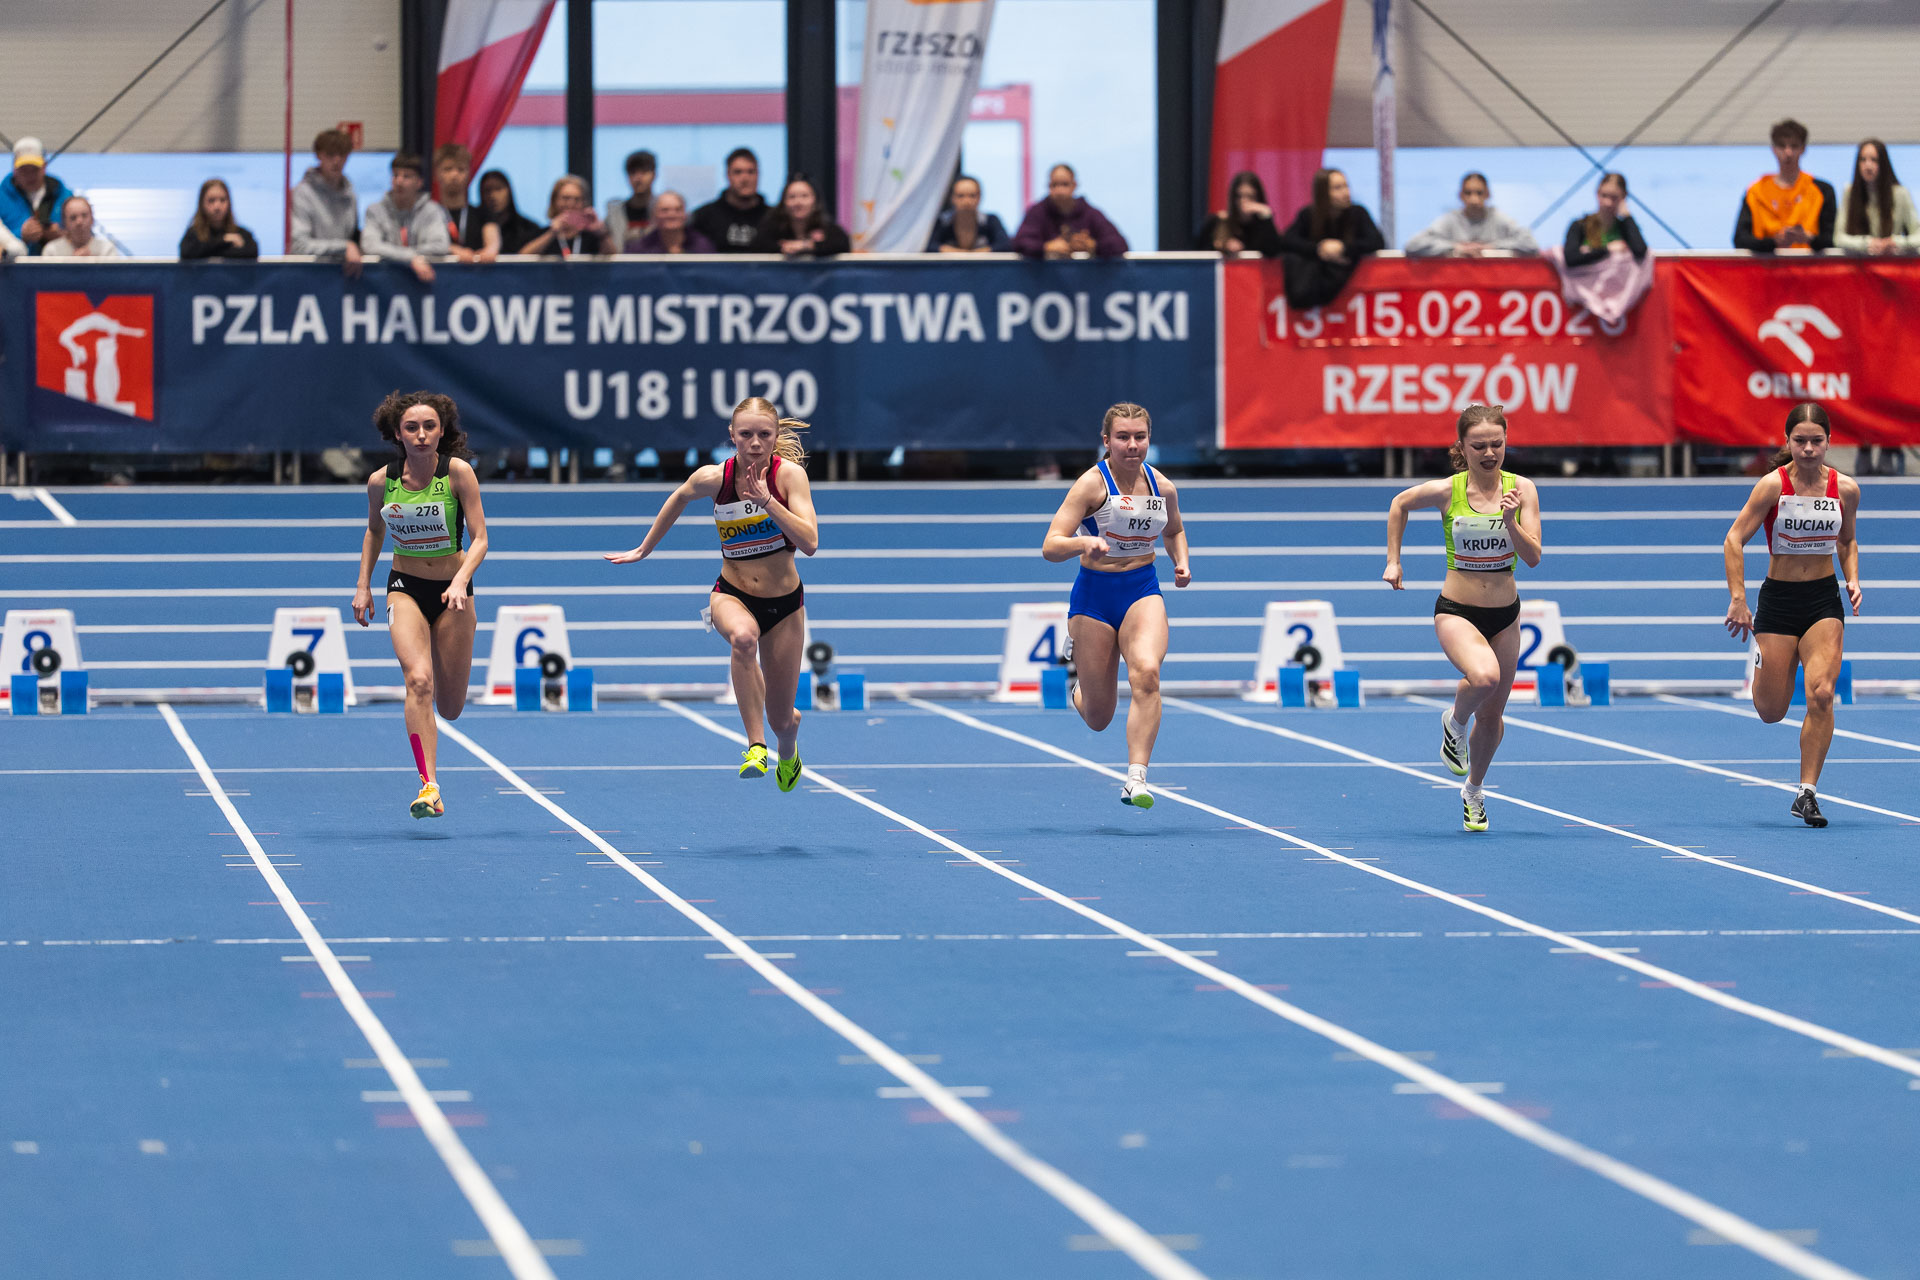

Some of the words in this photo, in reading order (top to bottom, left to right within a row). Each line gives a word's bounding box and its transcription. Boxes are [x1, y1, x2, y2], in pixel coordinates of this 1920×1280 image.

[193, 295, 328, 344] PZLA
[342, 295, 575, 344] HALOWE
[587, 293, 986, 344] MISTRZOSTWA
[997, 291, 1189, 342] POLSKI
[564, 369, 671, 420] U18
[682, 367, 698, 419] i
[711, 369, 818, 418] U20
[1323, 353, 1578, 414] RZESZÓW
[1747, 371, 1850, 400] ORLEN
[415, 505, 440, 517] 278
[1146, 499, 1162, 511] 187
[1813, 500, 1836, 511] 821
[388, 522, 446, 535] SUKIENNIK
[720, 520, 776, 539] GONDEK
[1128, 516, 1152, 531] RYŚ
[1488, 519, 1507, 530] 77
[1784, 518, 1835, 531] BUCIAK
[1462, 538, 1507, 551] KRUPA
[22, 630, 52, 672] 8
[291, 628, 325, 655] 7
[515, 627, 546, 666] 6
[1028, 624, 1058, 664] 4
[1516, 623, 1542, 671] 2
